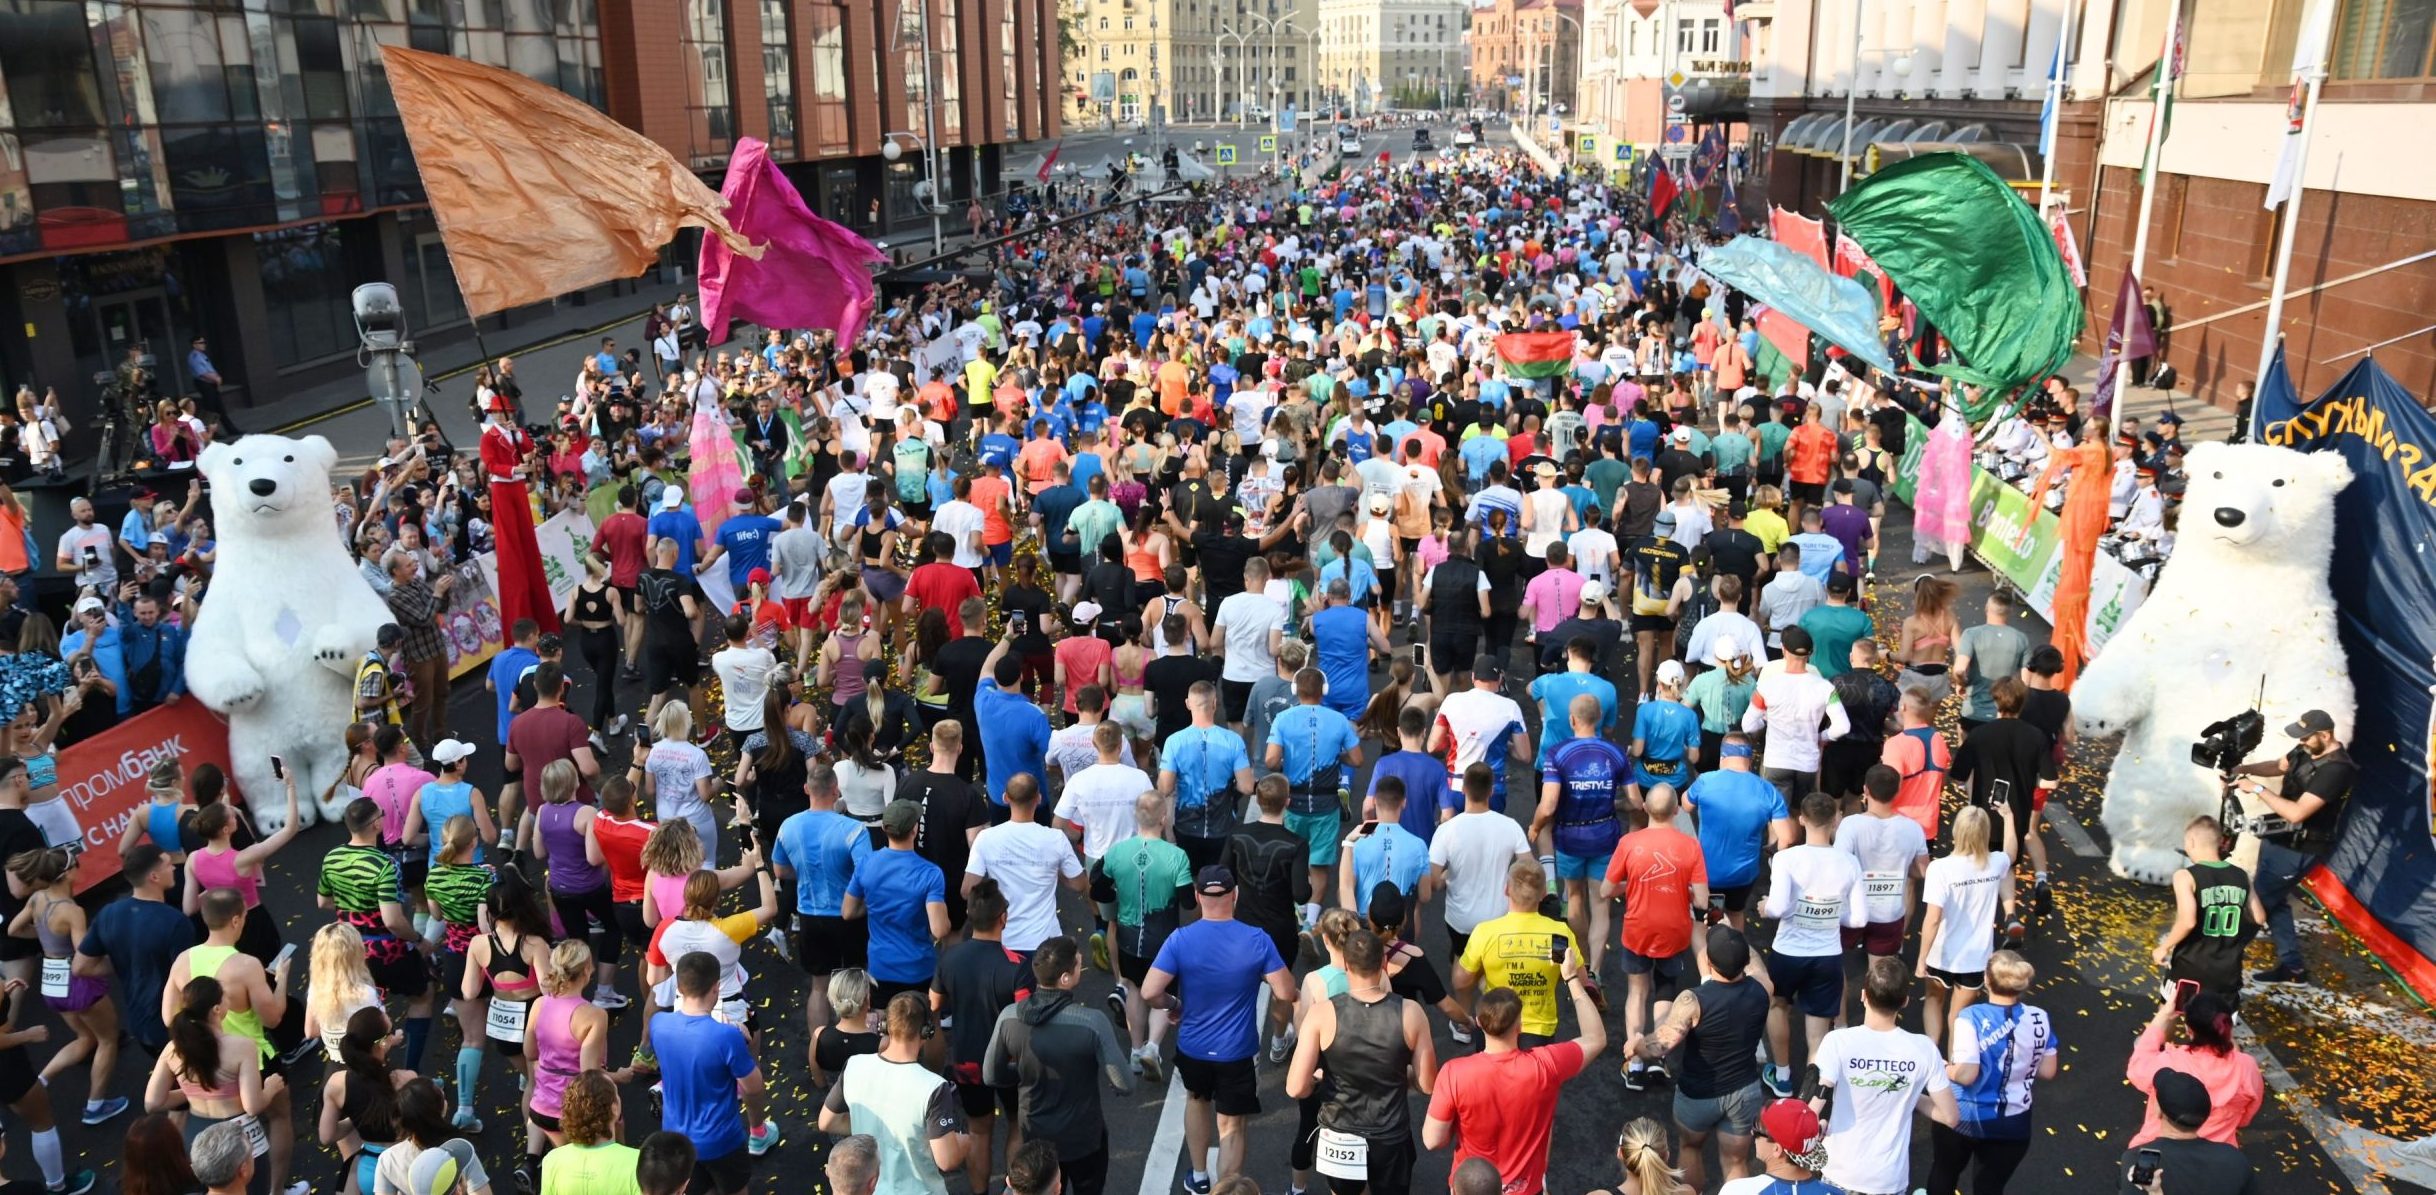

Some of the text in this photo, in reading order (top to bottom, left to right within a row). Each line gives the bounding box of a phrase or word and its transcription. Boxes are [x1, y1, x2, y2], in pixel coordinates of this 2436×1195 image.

[1433, 403, 1444, 420] 8
[2398, 443, 2436, 507] ЗА
[736, 528, 760, 542] life:)
[1976, 500, 2035, 560] Bonfeo
[1569, 779, 1613, 791] TRISTYLE
[1868, 884, 1895, 892] 11897
[1805, 906, 1834, 916] 11899
[2203, 905, 2241, 937] 00
[1508, 979, 1548, 988] WARRIOR
[1509, 972, 1535, 981] TOTAL
[492, 1011, 516, 1025] 11054
[1849, 1057, 1917, 1073] SOFTTECO
[1325, 1146, 1356, 1161] 12152
